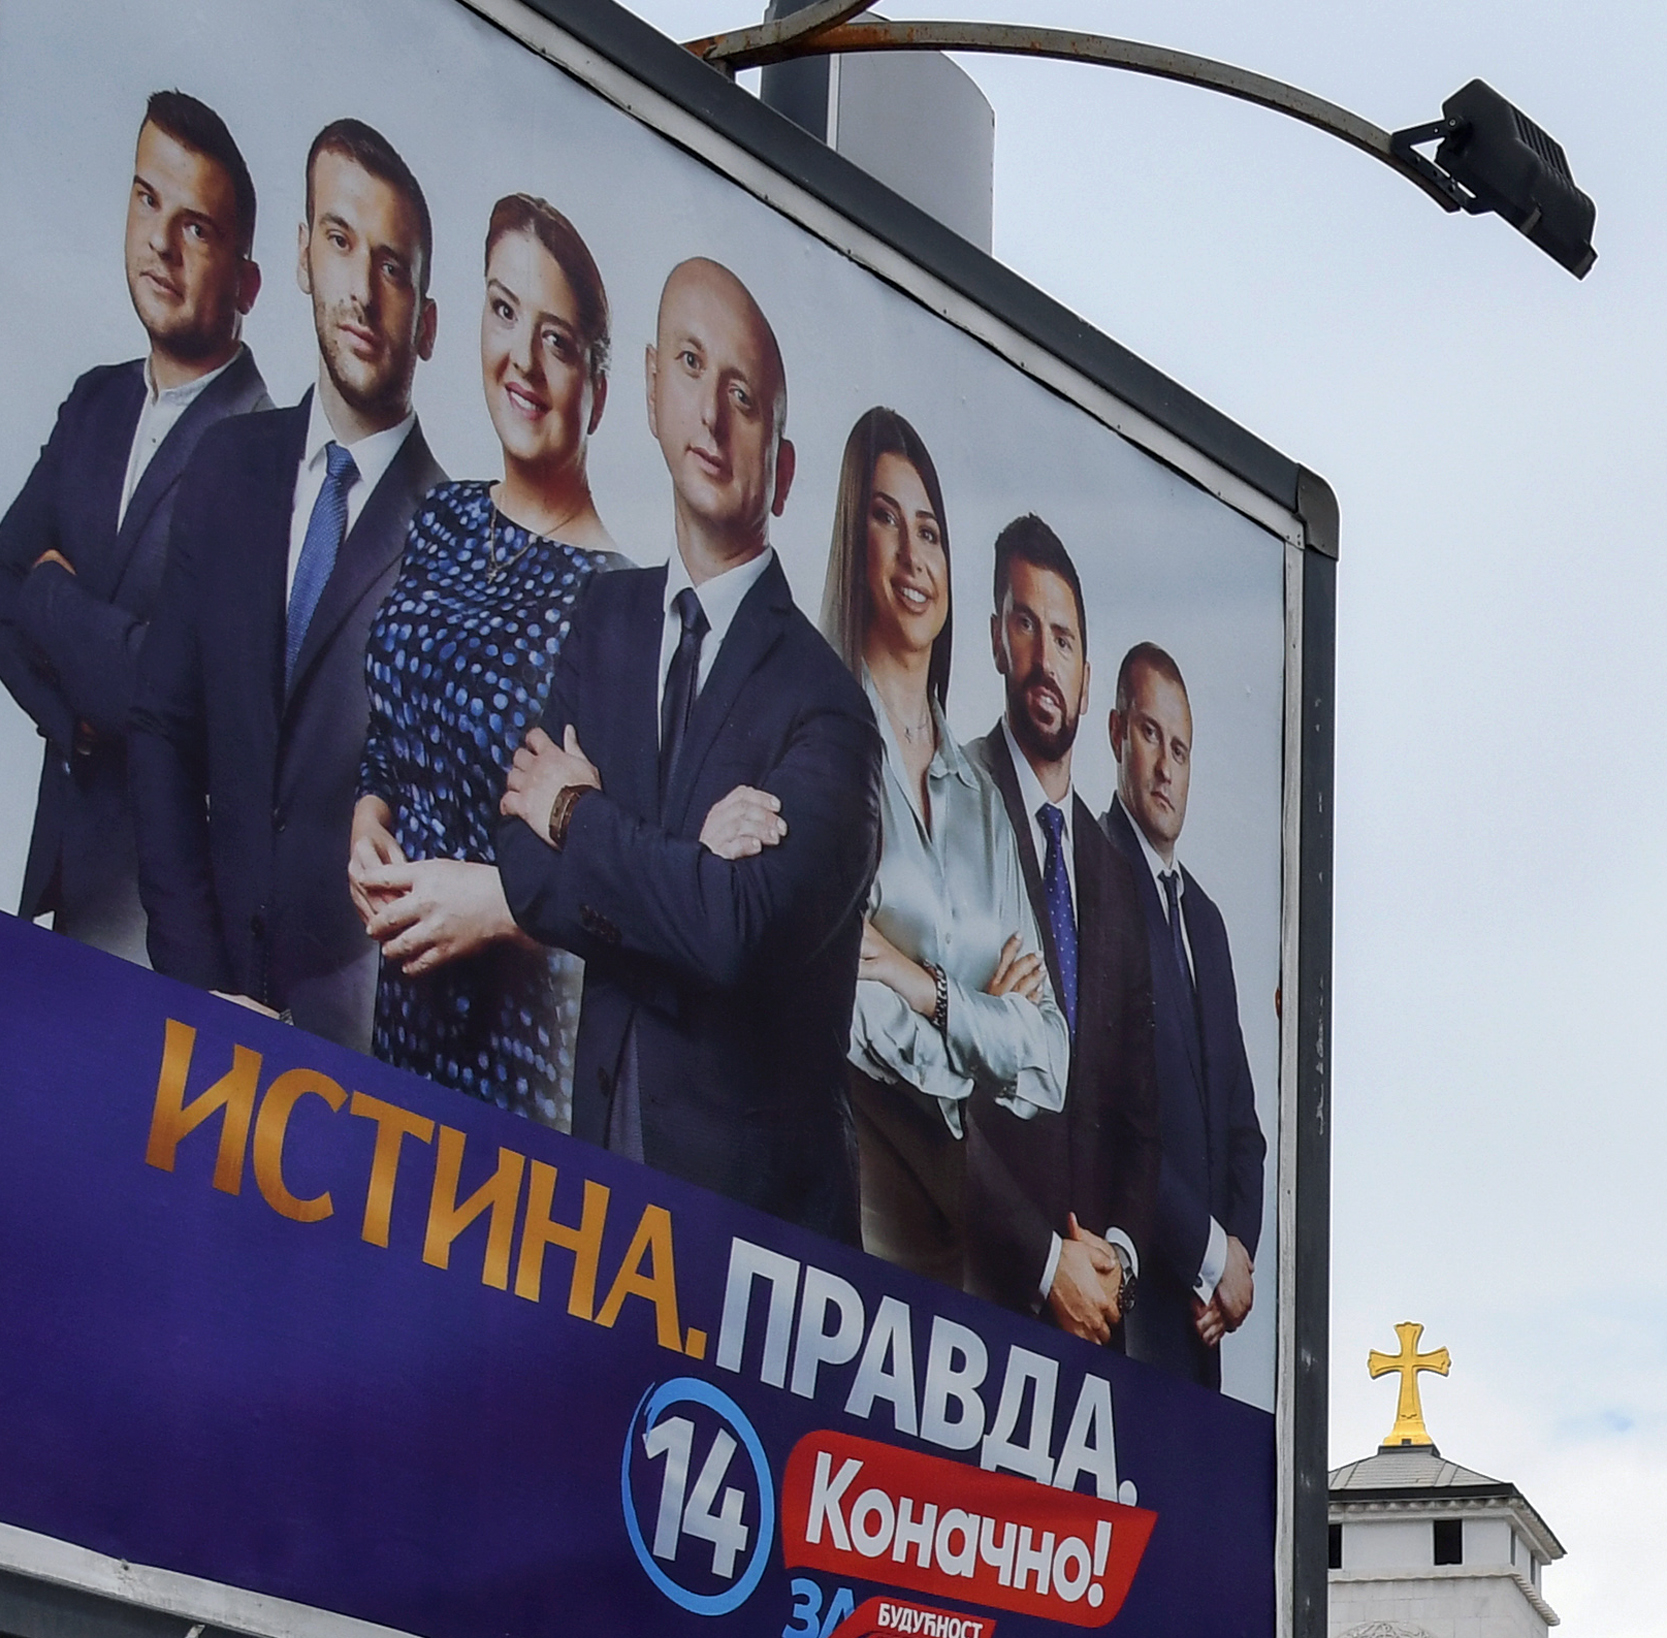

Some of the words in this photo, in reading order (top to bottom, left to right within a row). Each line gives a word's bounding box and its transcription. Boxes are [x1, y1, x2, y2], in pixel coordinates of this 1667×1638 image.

[144, 1018, 707, 1361] ИСТИНА.
[716, 1237, 1138, 1507] ПРАВДА.
[643, 1415, 749, 1579] 14
[806, 1452, 1113, 1608] Коначно!
